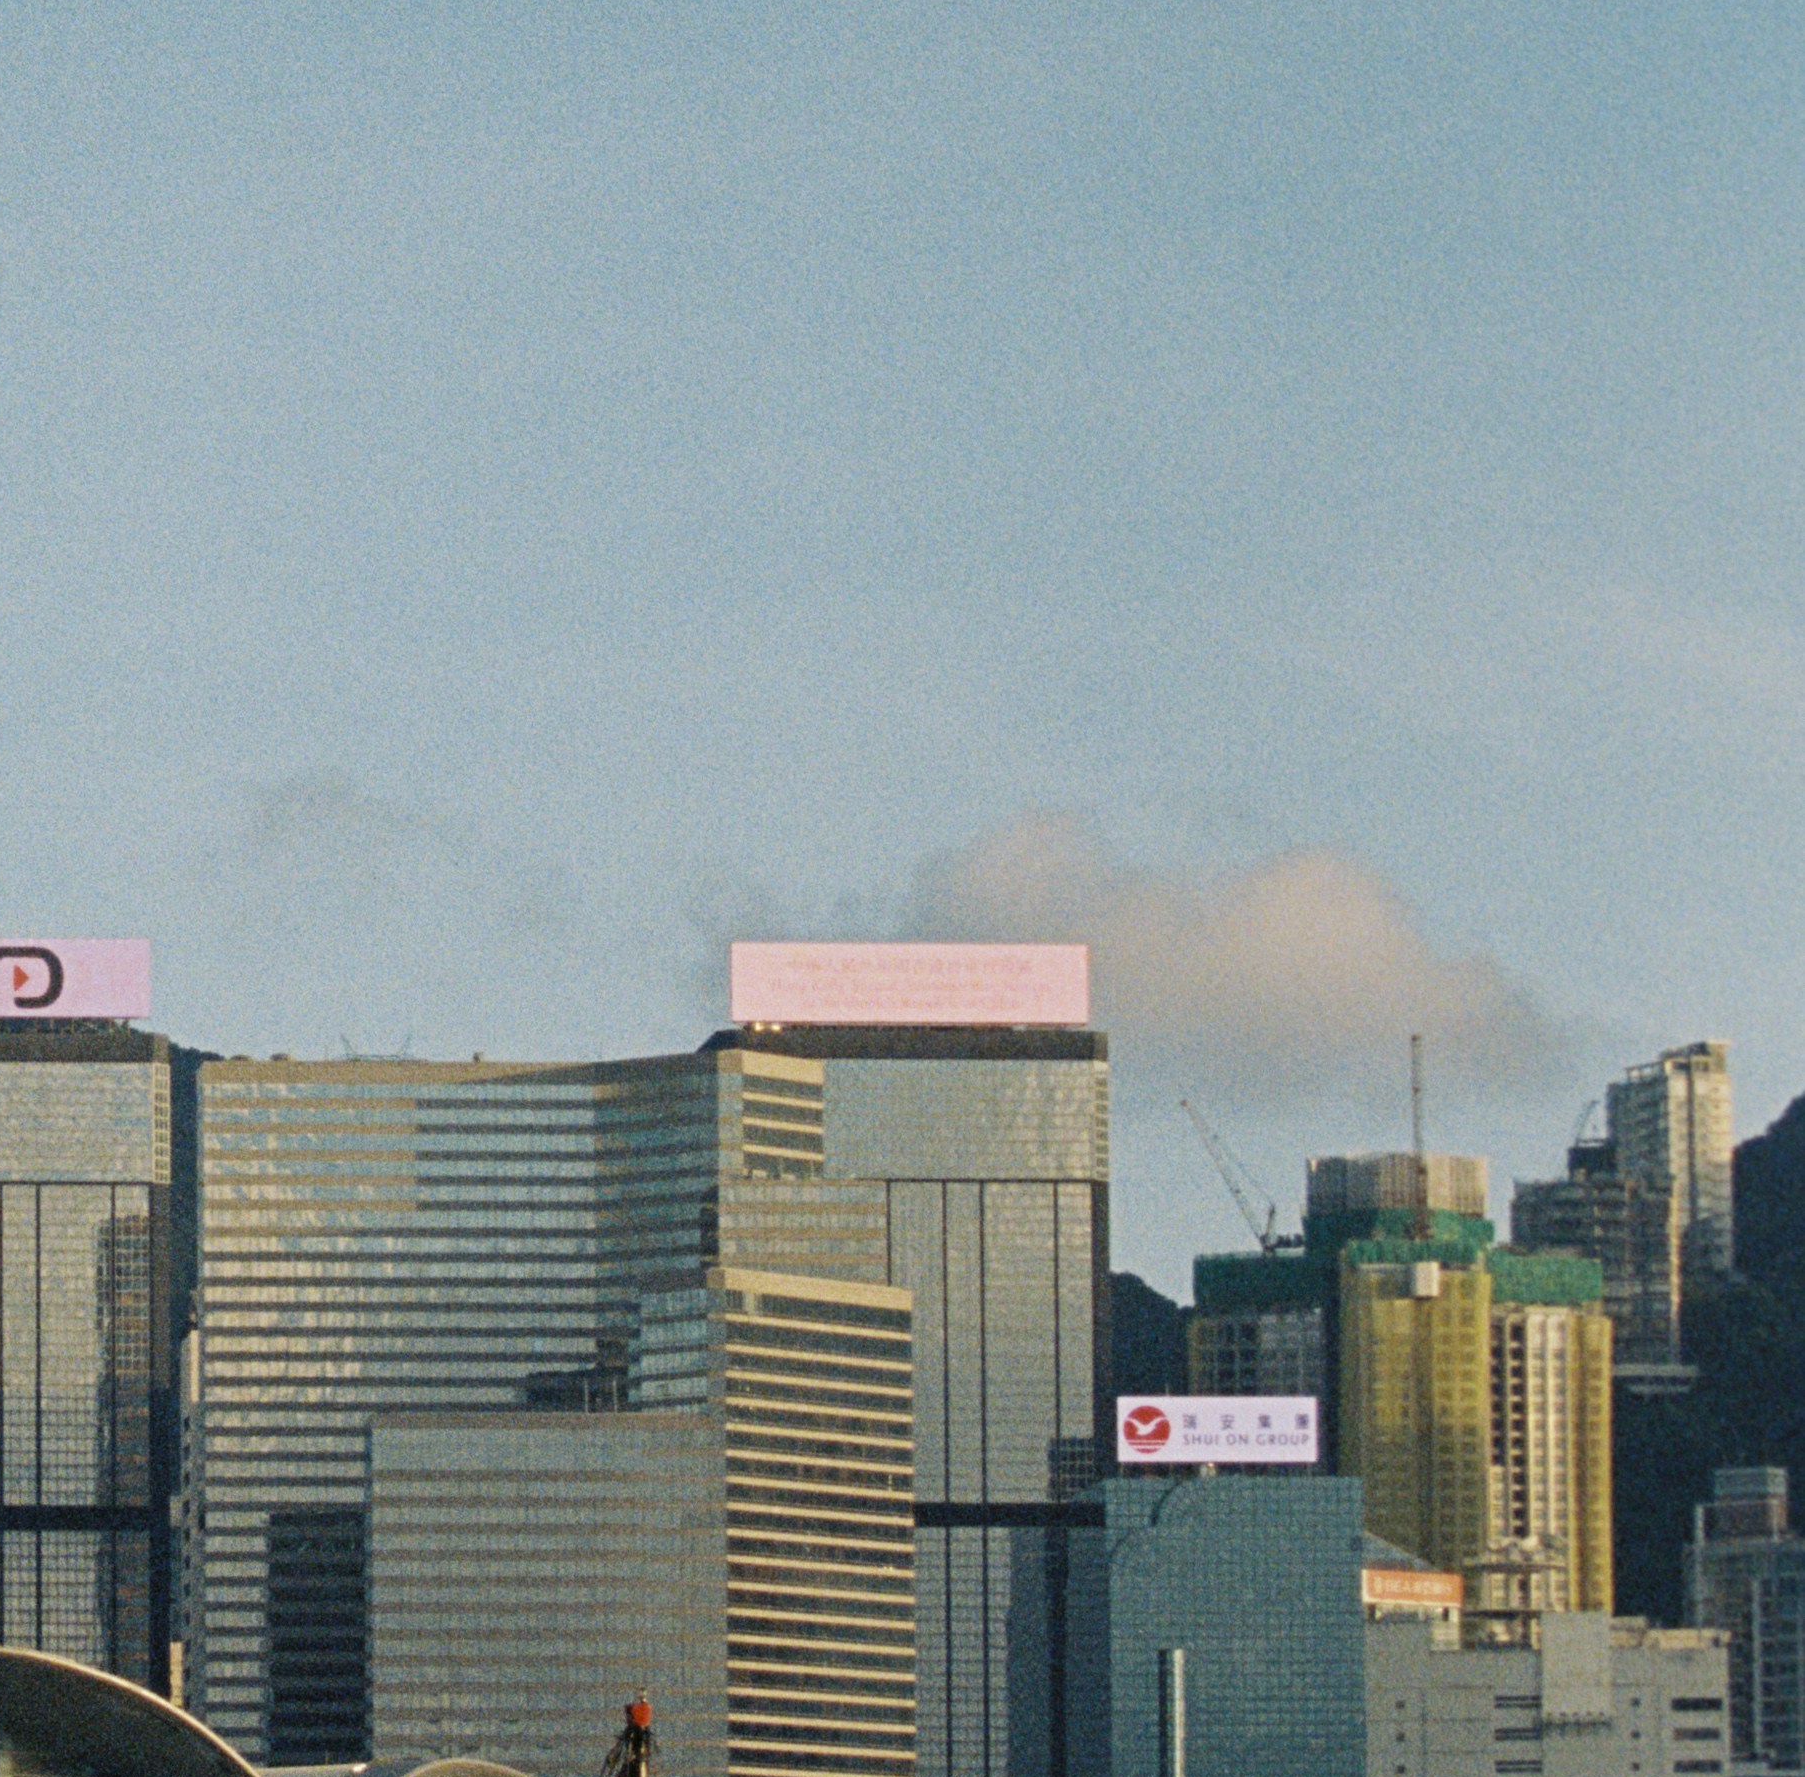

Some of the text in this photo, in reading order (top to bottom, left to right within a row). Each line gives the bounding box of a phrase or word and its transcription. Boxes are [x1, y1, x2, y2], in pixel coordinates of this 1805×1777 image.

[1182, 1433, 1310, 1447] SHUI ON GROUP
